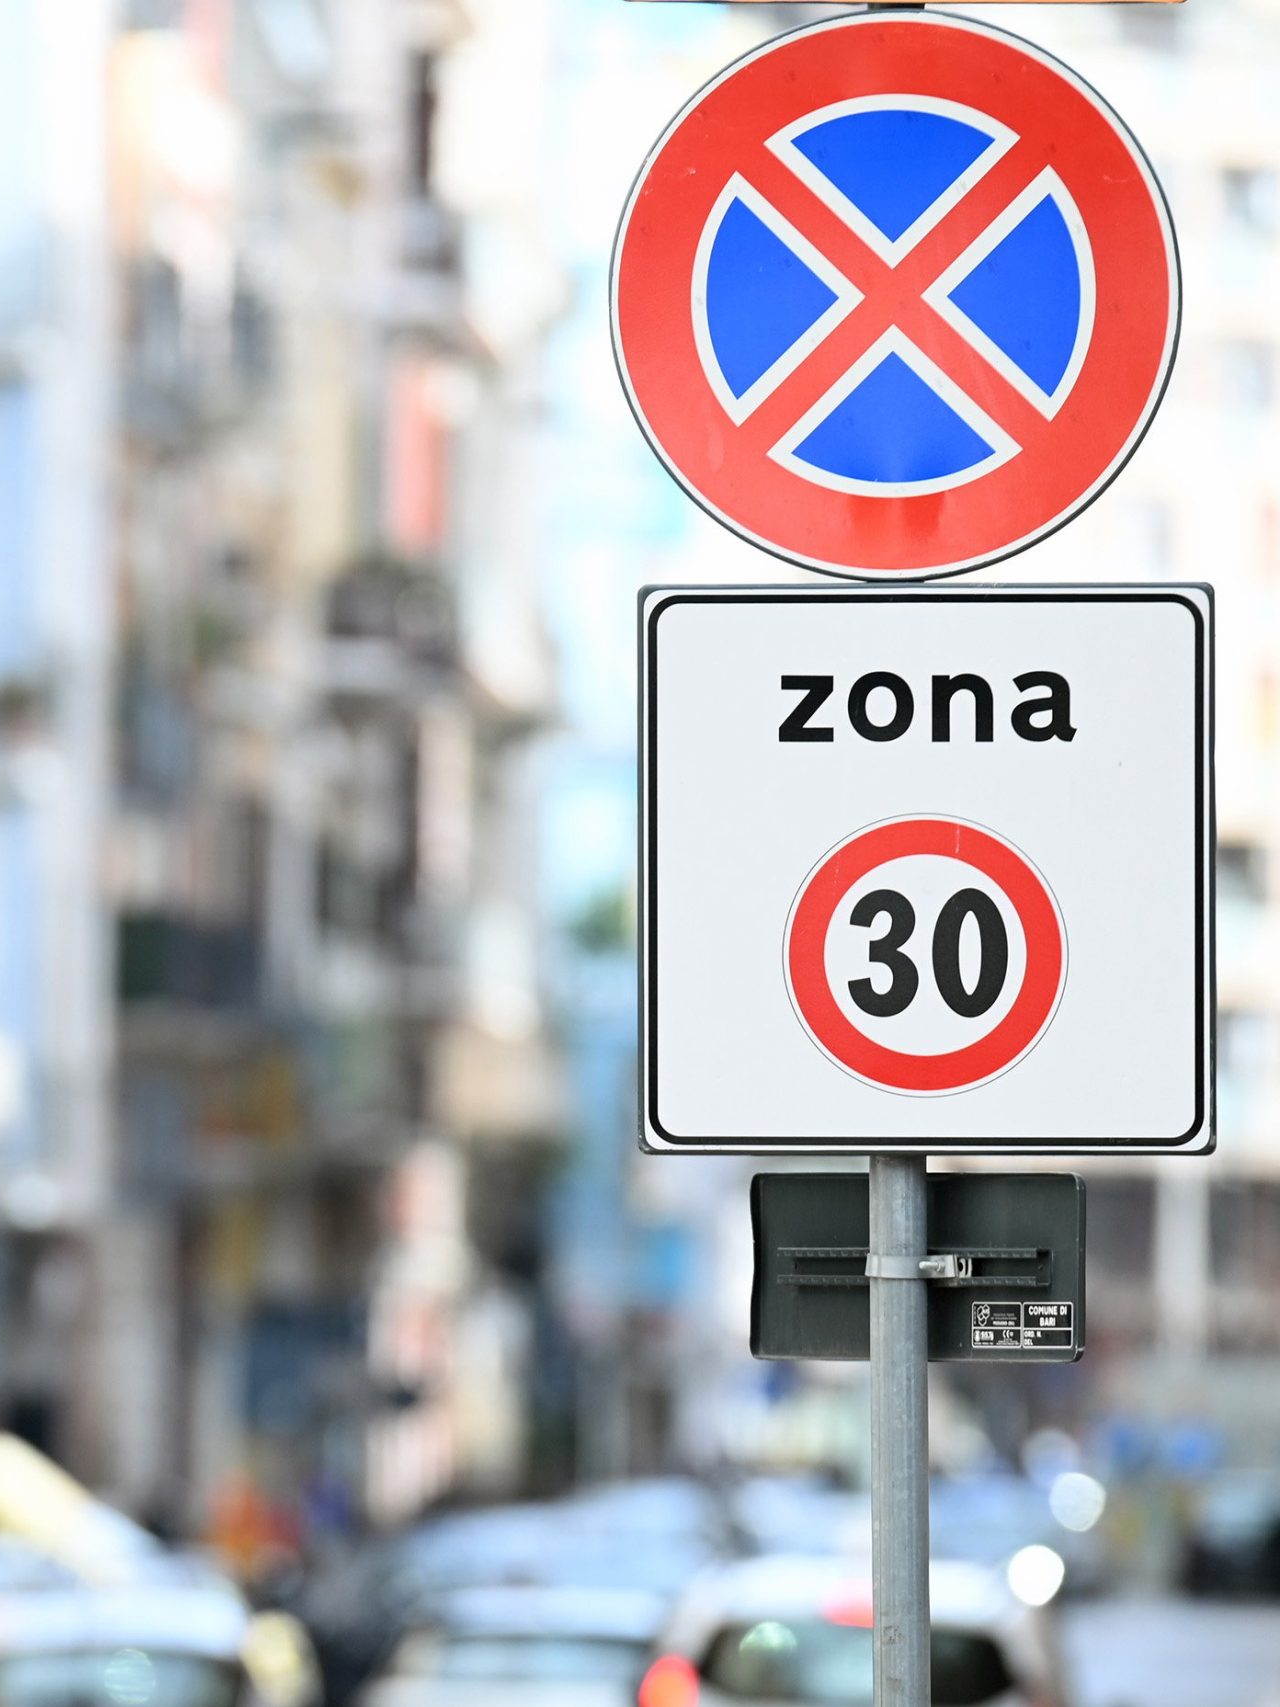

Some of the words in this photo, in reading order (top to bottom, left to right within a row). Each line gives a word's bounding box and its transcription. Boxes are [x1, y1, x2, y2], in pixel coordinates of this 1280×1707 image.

[779, 671, 1077, 743] zona
[847, 888, 1009, 1018] 30
[1028, 1305, 1058, 1316] COMUNE
[1060, 1305, 1067, 1316] DI
[1039, 1317, 1056, 1327] BARI
